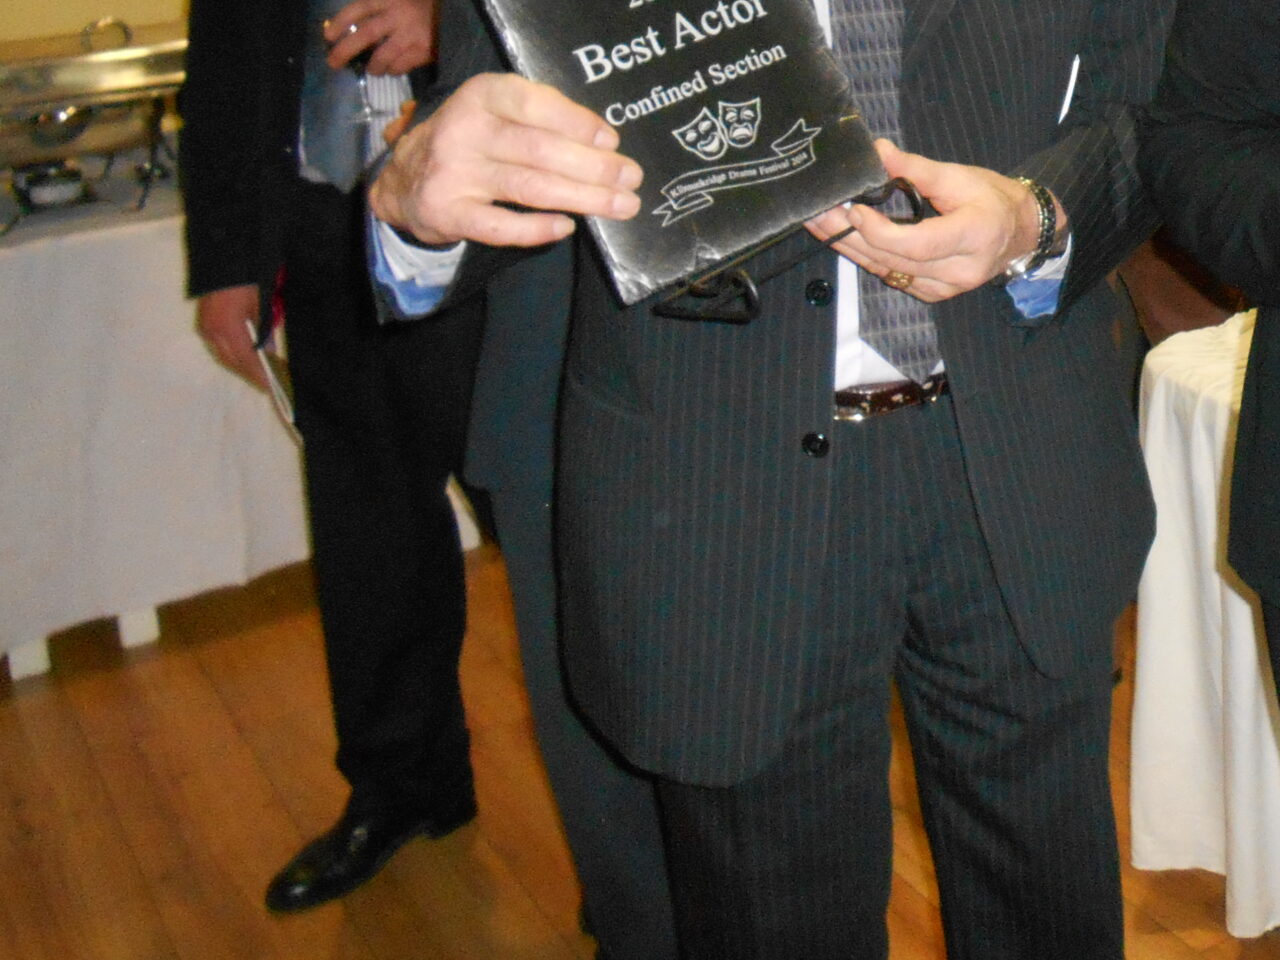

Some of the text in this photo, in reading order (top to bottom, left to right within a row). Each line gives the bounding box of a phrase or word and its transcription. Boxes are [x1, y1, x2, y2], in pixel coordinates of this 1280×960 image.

[573, 26, 666, 83] Best
[605, 42, 787, 127] Confined Section
